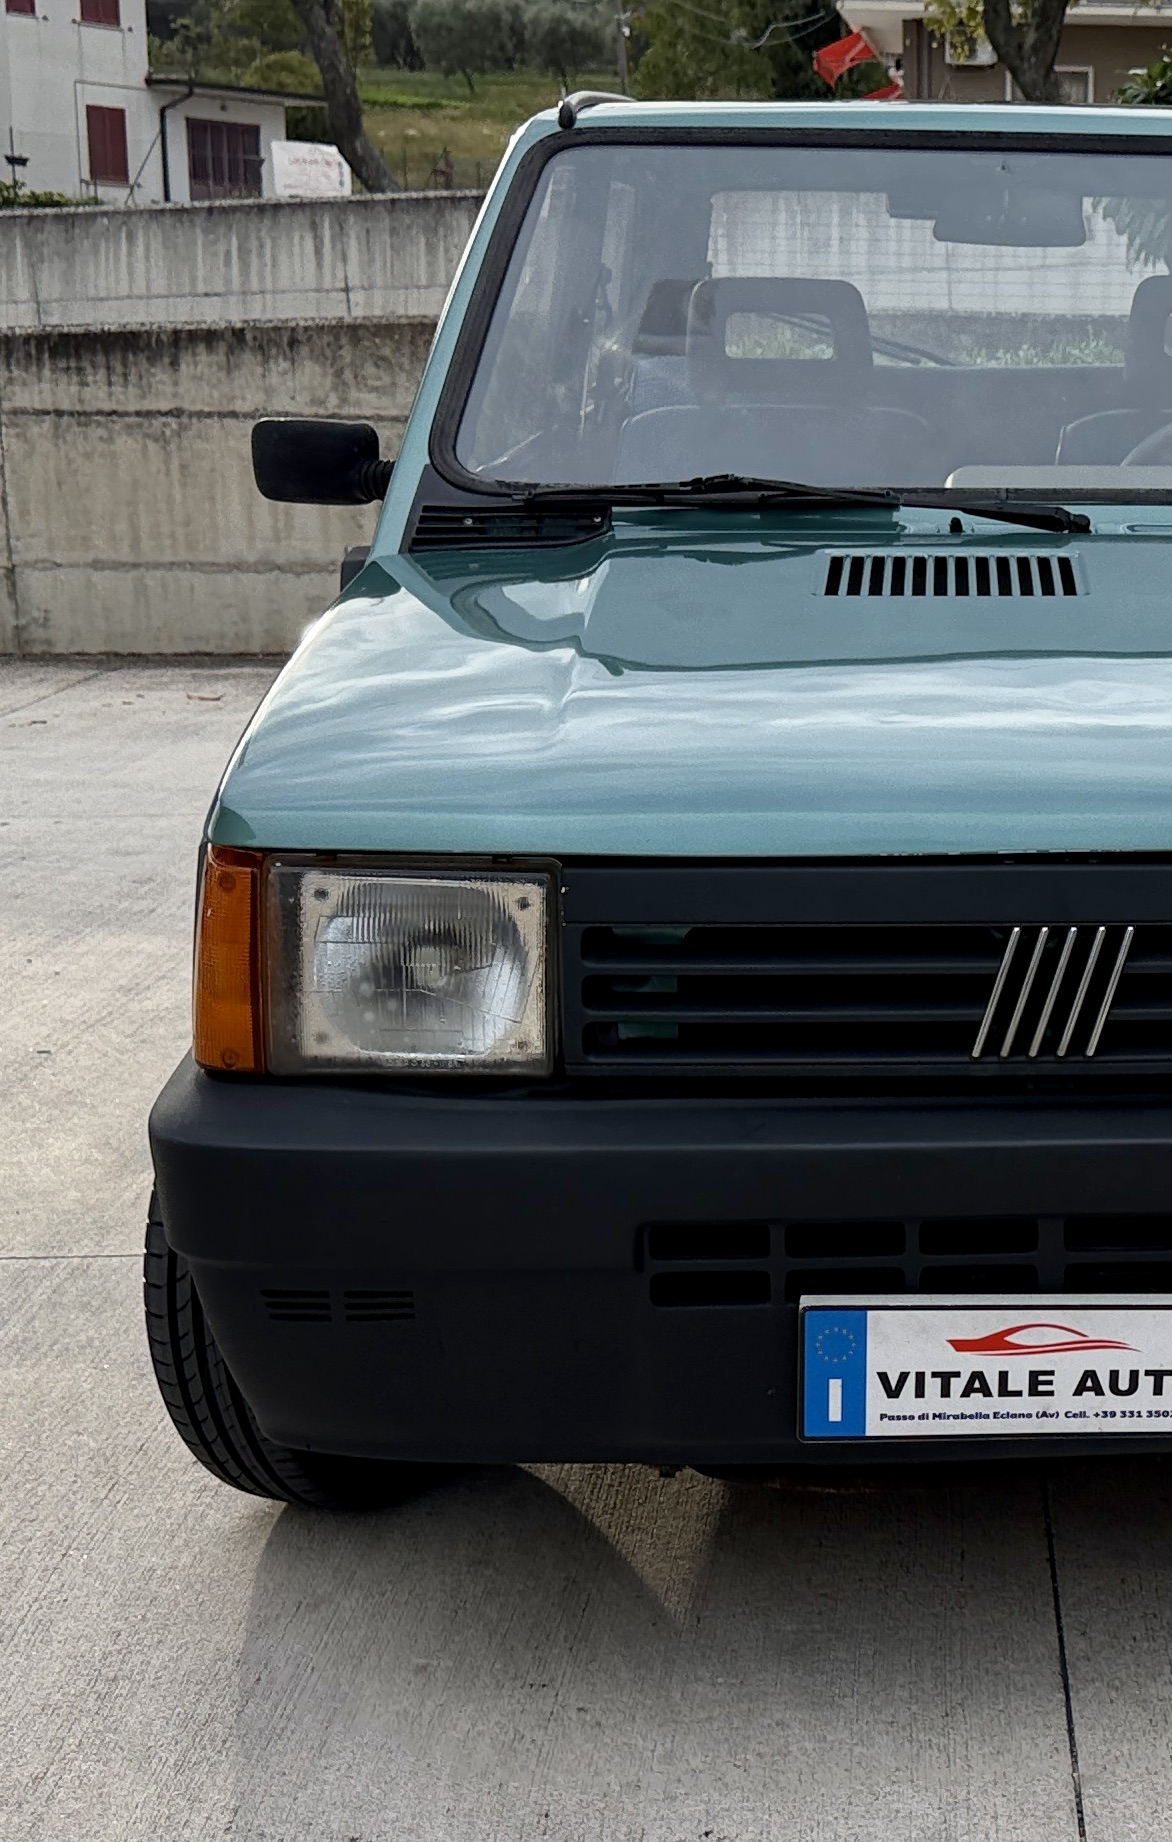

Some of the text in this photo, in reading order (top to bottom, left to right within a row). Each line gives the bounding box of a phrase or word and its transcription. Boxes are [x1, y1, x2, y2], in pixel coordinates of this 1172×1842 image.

[876, 1369, 1056, 1399] VITALE
[879, 1412, 916, 1422] Passo
[917, 1411, 930, 1421] di
[931, 1411, 991, 1421] Mirabella
[992, 1410, 1033, 1420] Eclano
[1035, 1410, 1060, 1420] (Av)
[1064, 1410, 1091, 1419] Cell.
[1092, 1410, 1117, 1419] +39
[1119, 1410, 1144, 1419] 331
